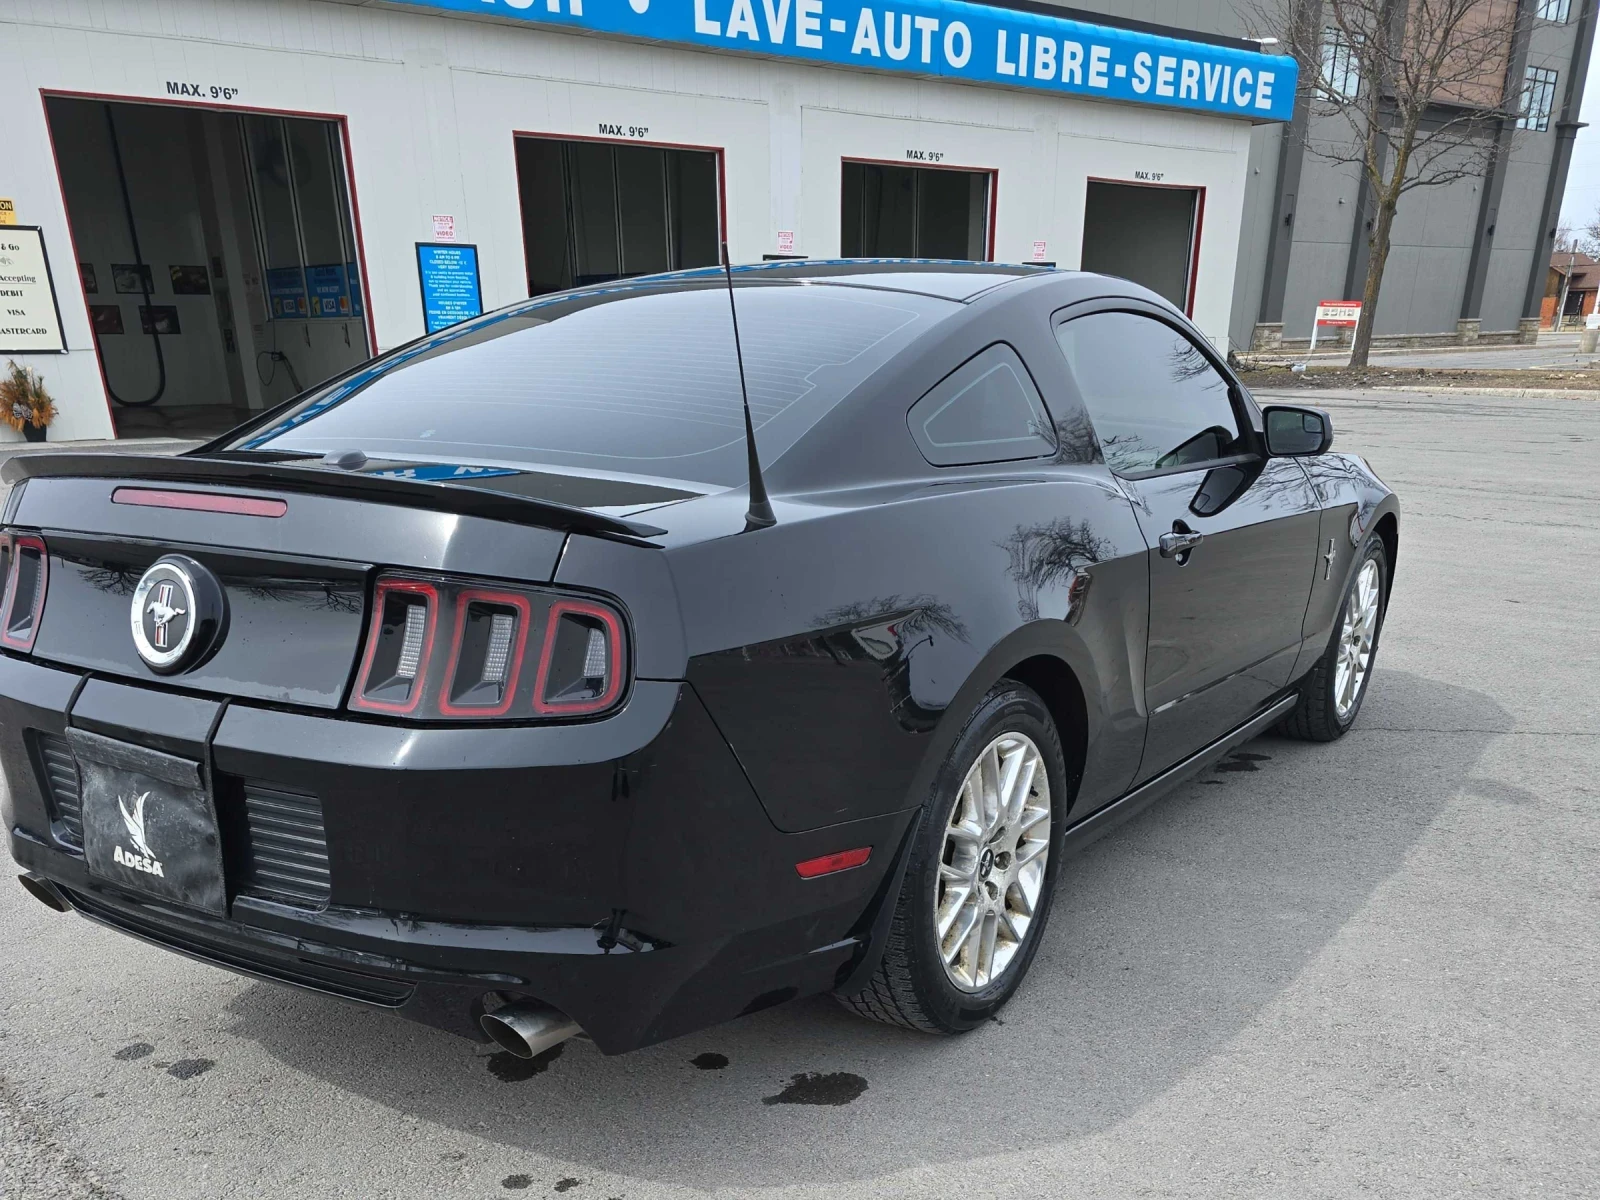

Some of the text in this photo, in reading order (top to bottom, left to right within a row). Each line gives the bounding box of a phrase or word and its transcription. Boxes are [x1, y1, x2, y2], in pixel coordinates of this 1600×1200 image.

[694, 0, 1275, 110] LAVE-AUTO LIBRE-SERVICE
[166, 81, 206, 97] MAX.
[599, 124, 626, 136] MAX.
[906, 149, 926, 160] MAX.
[1135, 170, 1150, 181] MAX.
[1, 243, 20, 251] & Go
[0, 274, 36, 284] Accepting
[323, 299, 335, 310] VISA
[113, 845, 164, 878] ADESA
